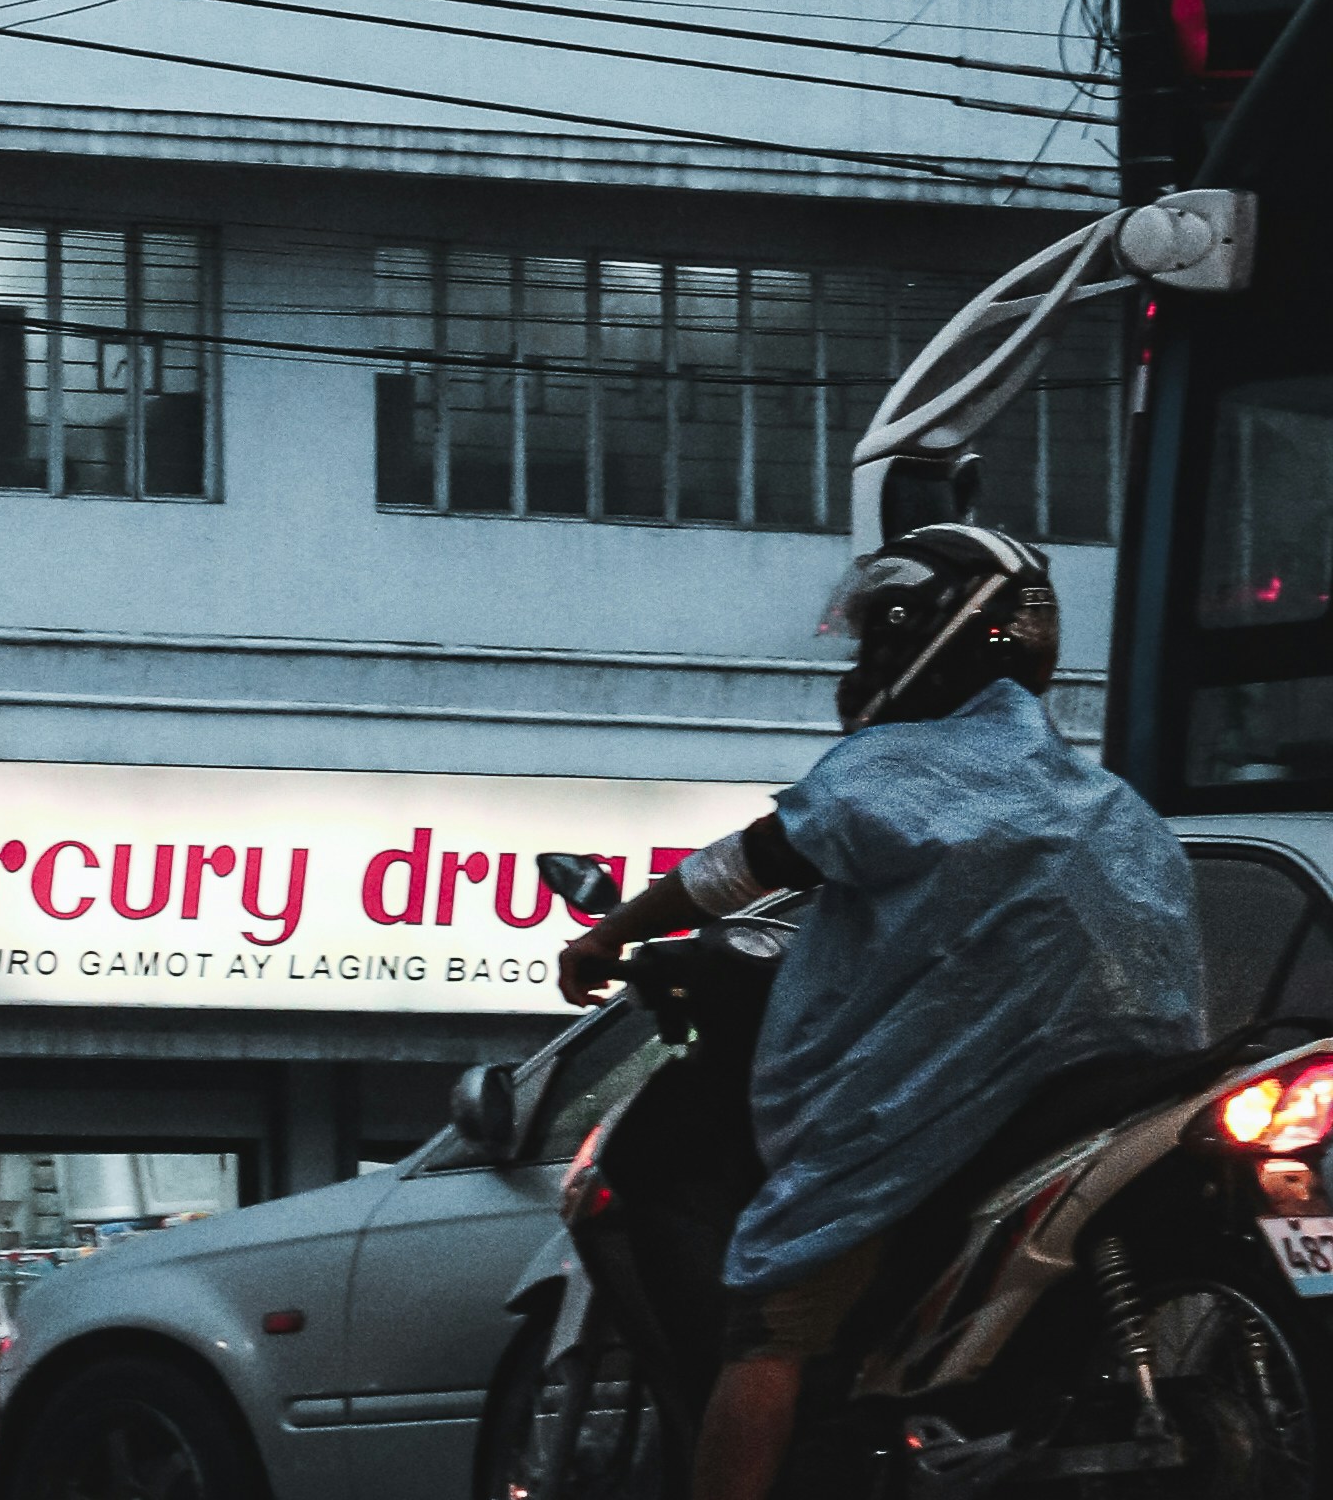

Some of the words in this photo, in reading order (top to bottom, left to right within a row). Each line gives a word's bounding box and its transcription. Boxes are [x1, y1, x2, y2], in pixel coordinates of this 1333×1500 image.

[79, 949, 213, 976] GAMOT
[227, 952, 276, 978] AY
[290, 953, 425, 980] LAGING
[445, 956, 547, 983] BAGO
